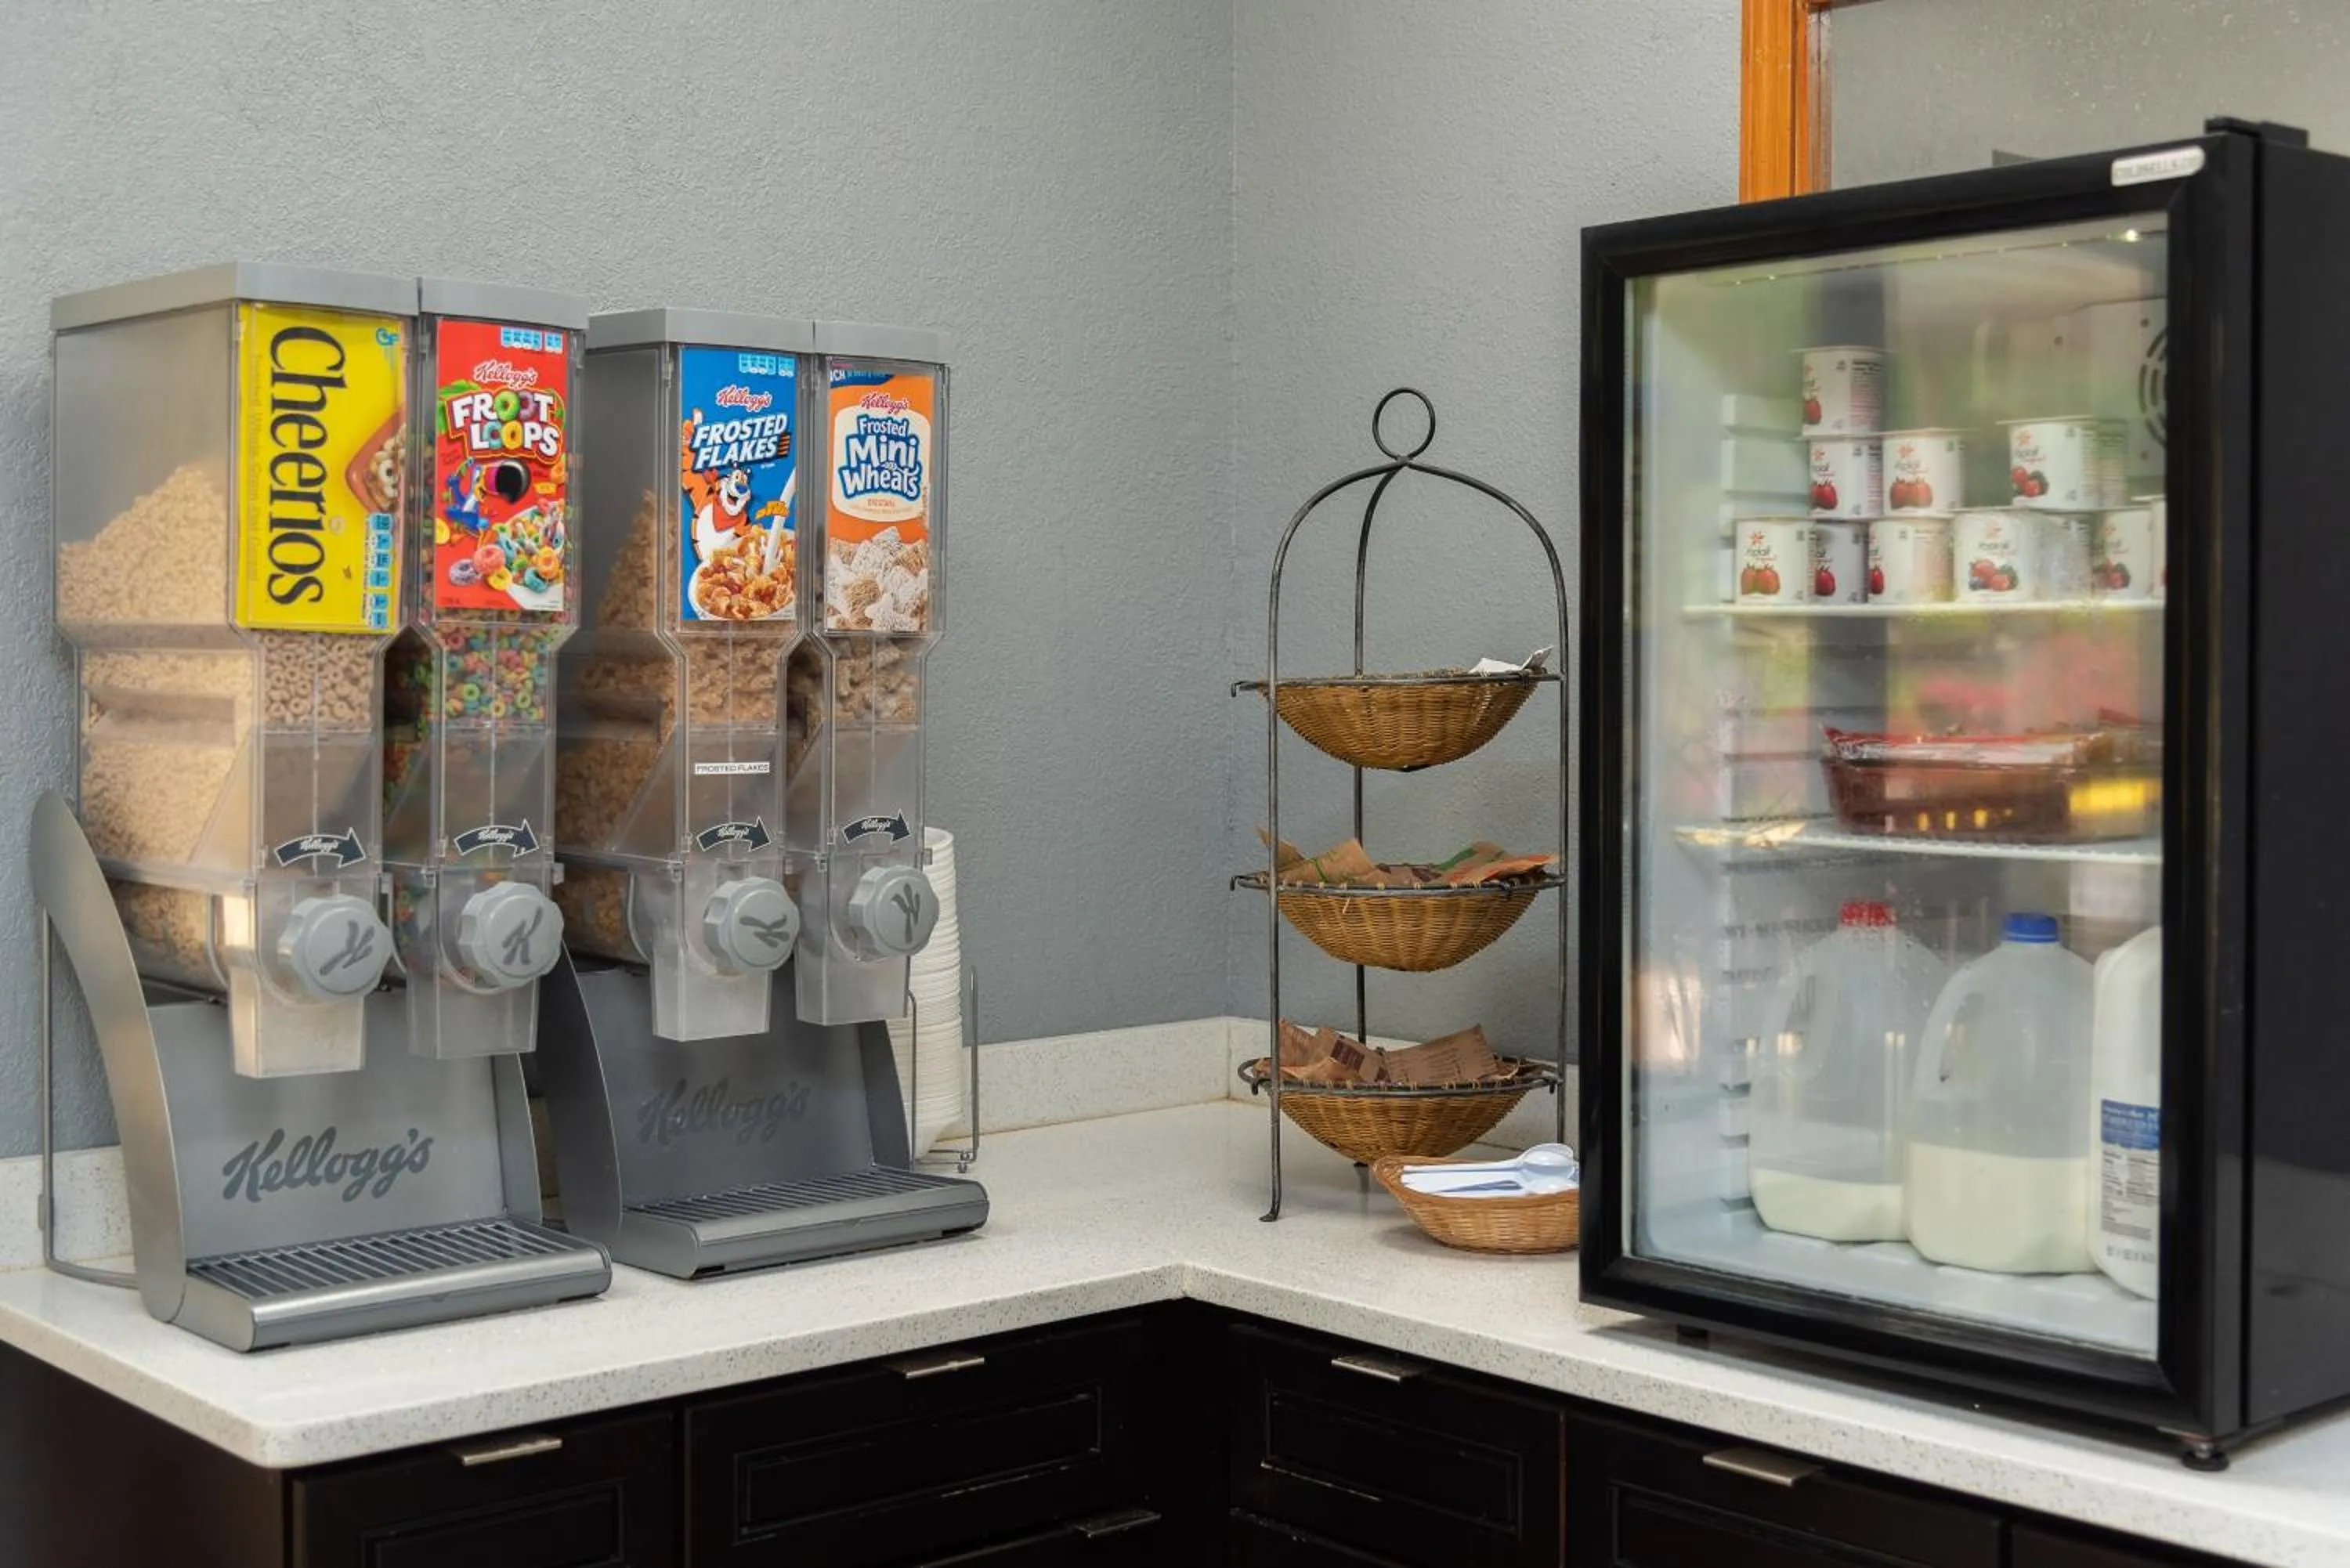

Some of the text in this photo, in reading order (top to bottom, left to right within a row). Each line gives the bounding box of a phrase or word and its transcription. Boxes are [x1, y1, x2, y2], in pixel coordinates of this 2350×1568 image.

[475, 359, 537, 389] Kellogg's
[452, 392, 553, 428] FROOT
[716, 383, 772, 412] Kellogg's
[860, 391, 909, 415] Kellogg's
[471, 420, 559, 456] LOOPS
[692, 414, 787, 449] FROSTED
[859, 417, 907, 436] Frosted
[266, 326, 348, 605] Cheerios
[695, 435, 778, 471] FLAKES
[848, 435, 916, 468] Mini
[842, 463, 919, 497] Wheats
[637, 1078, 811, 1146] Kellogg's
[222, 1125, 432, 1187] Kellogg's
